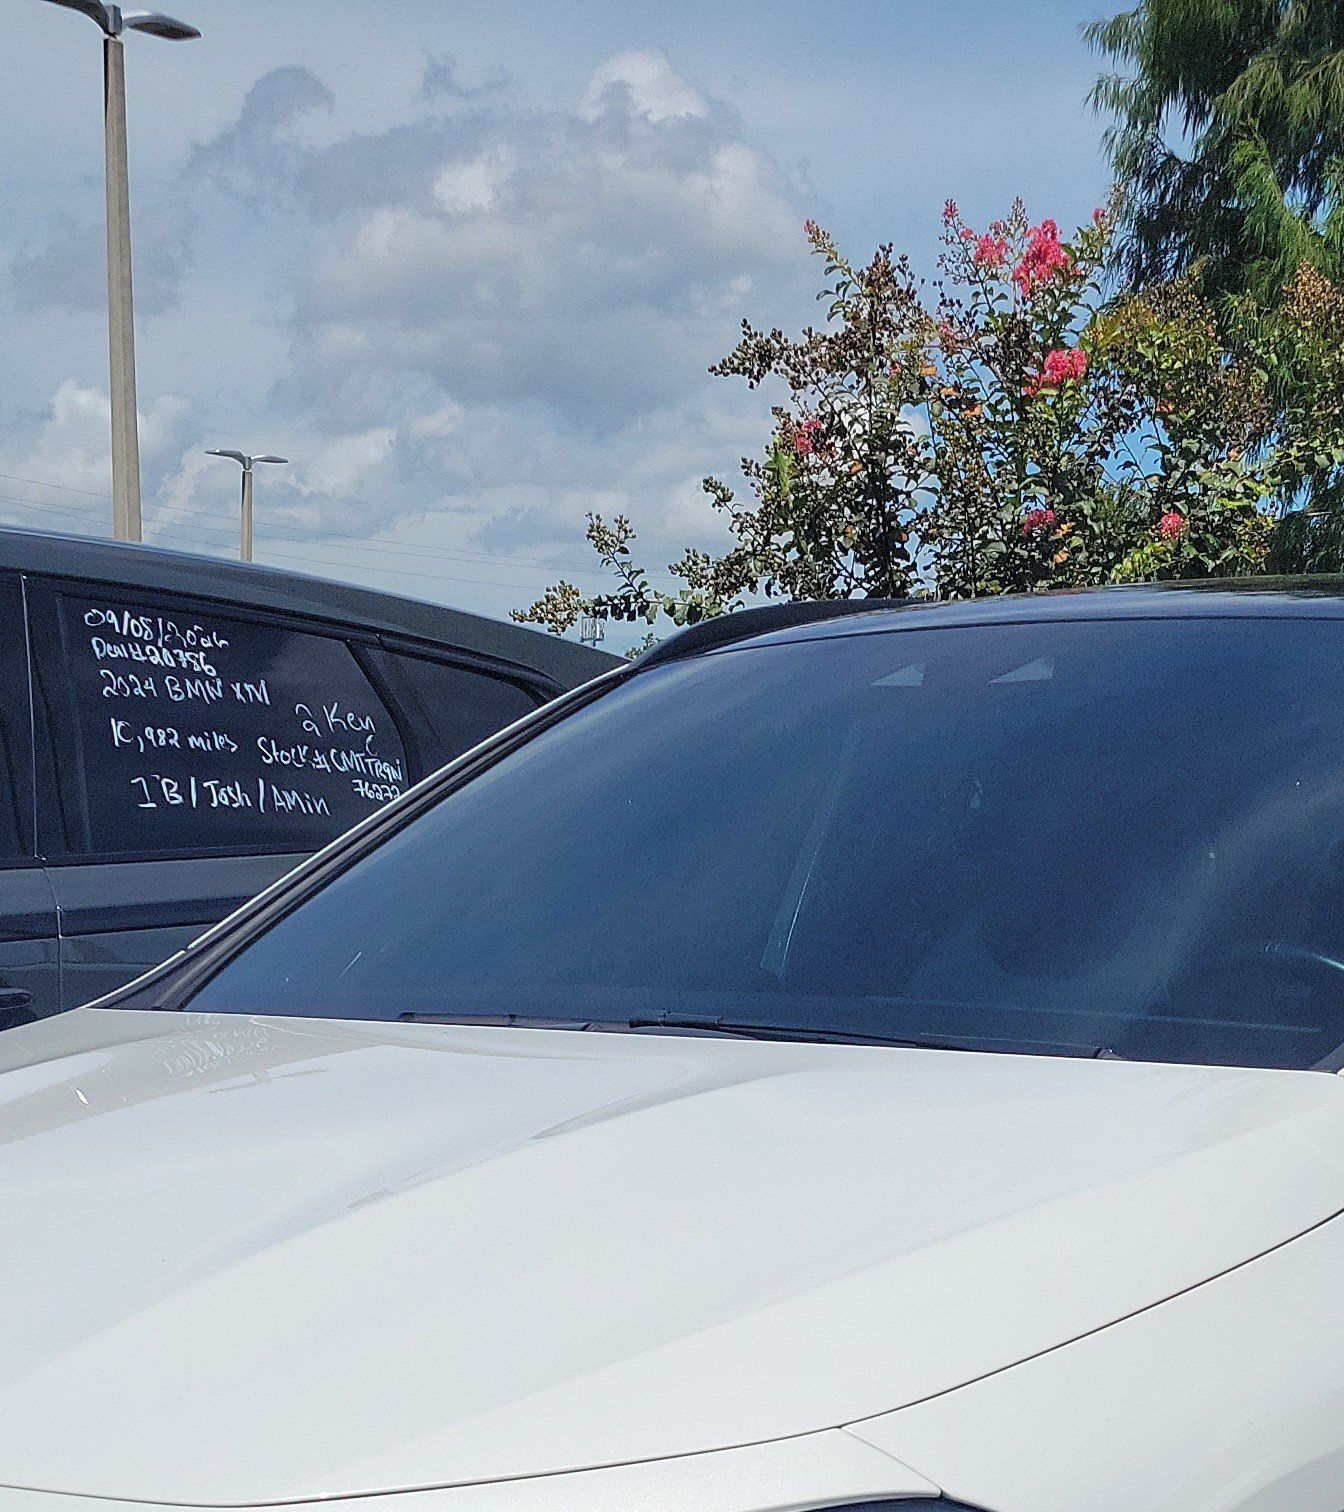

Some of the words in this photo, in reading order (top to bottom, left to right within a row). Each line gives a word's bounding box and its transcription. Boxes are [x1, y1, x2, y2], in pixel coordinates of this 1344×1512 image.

[100, 669, 157, 698] 2024
[165, 675, 223, 704] BMW
[295, 703, 322, 737] 2
[187, 731, 239, 752] miles
